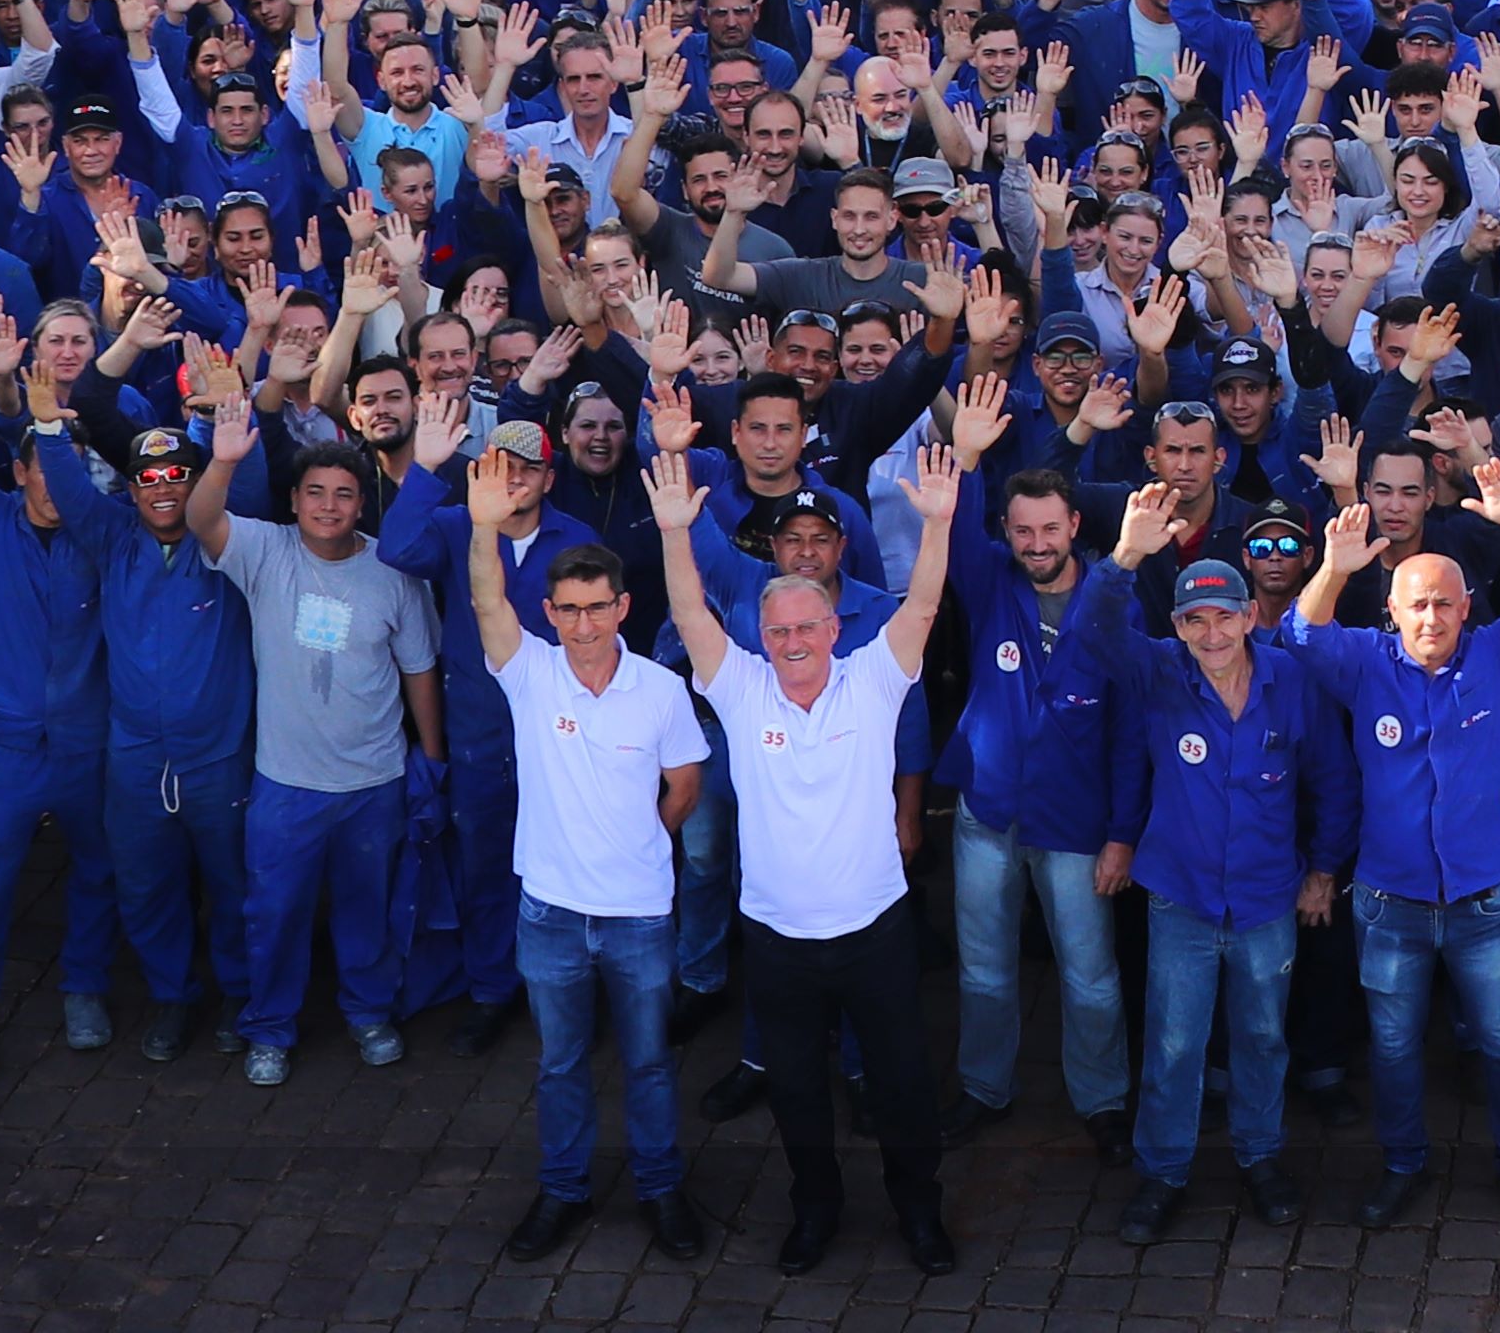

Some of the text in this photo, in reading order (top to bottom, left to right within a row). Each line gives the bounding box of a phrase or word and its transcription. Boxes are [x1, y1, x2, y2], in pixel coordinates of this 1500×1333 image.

[796, 491, 816, 507] NY
[1001, 644, 1019, 662] 30
[556, 716, 576, 733] 35
[1379, 722, 1397, 739] 35
[763, 730, 785, 747] 35
[1182, 739, 1203, 757] 35
